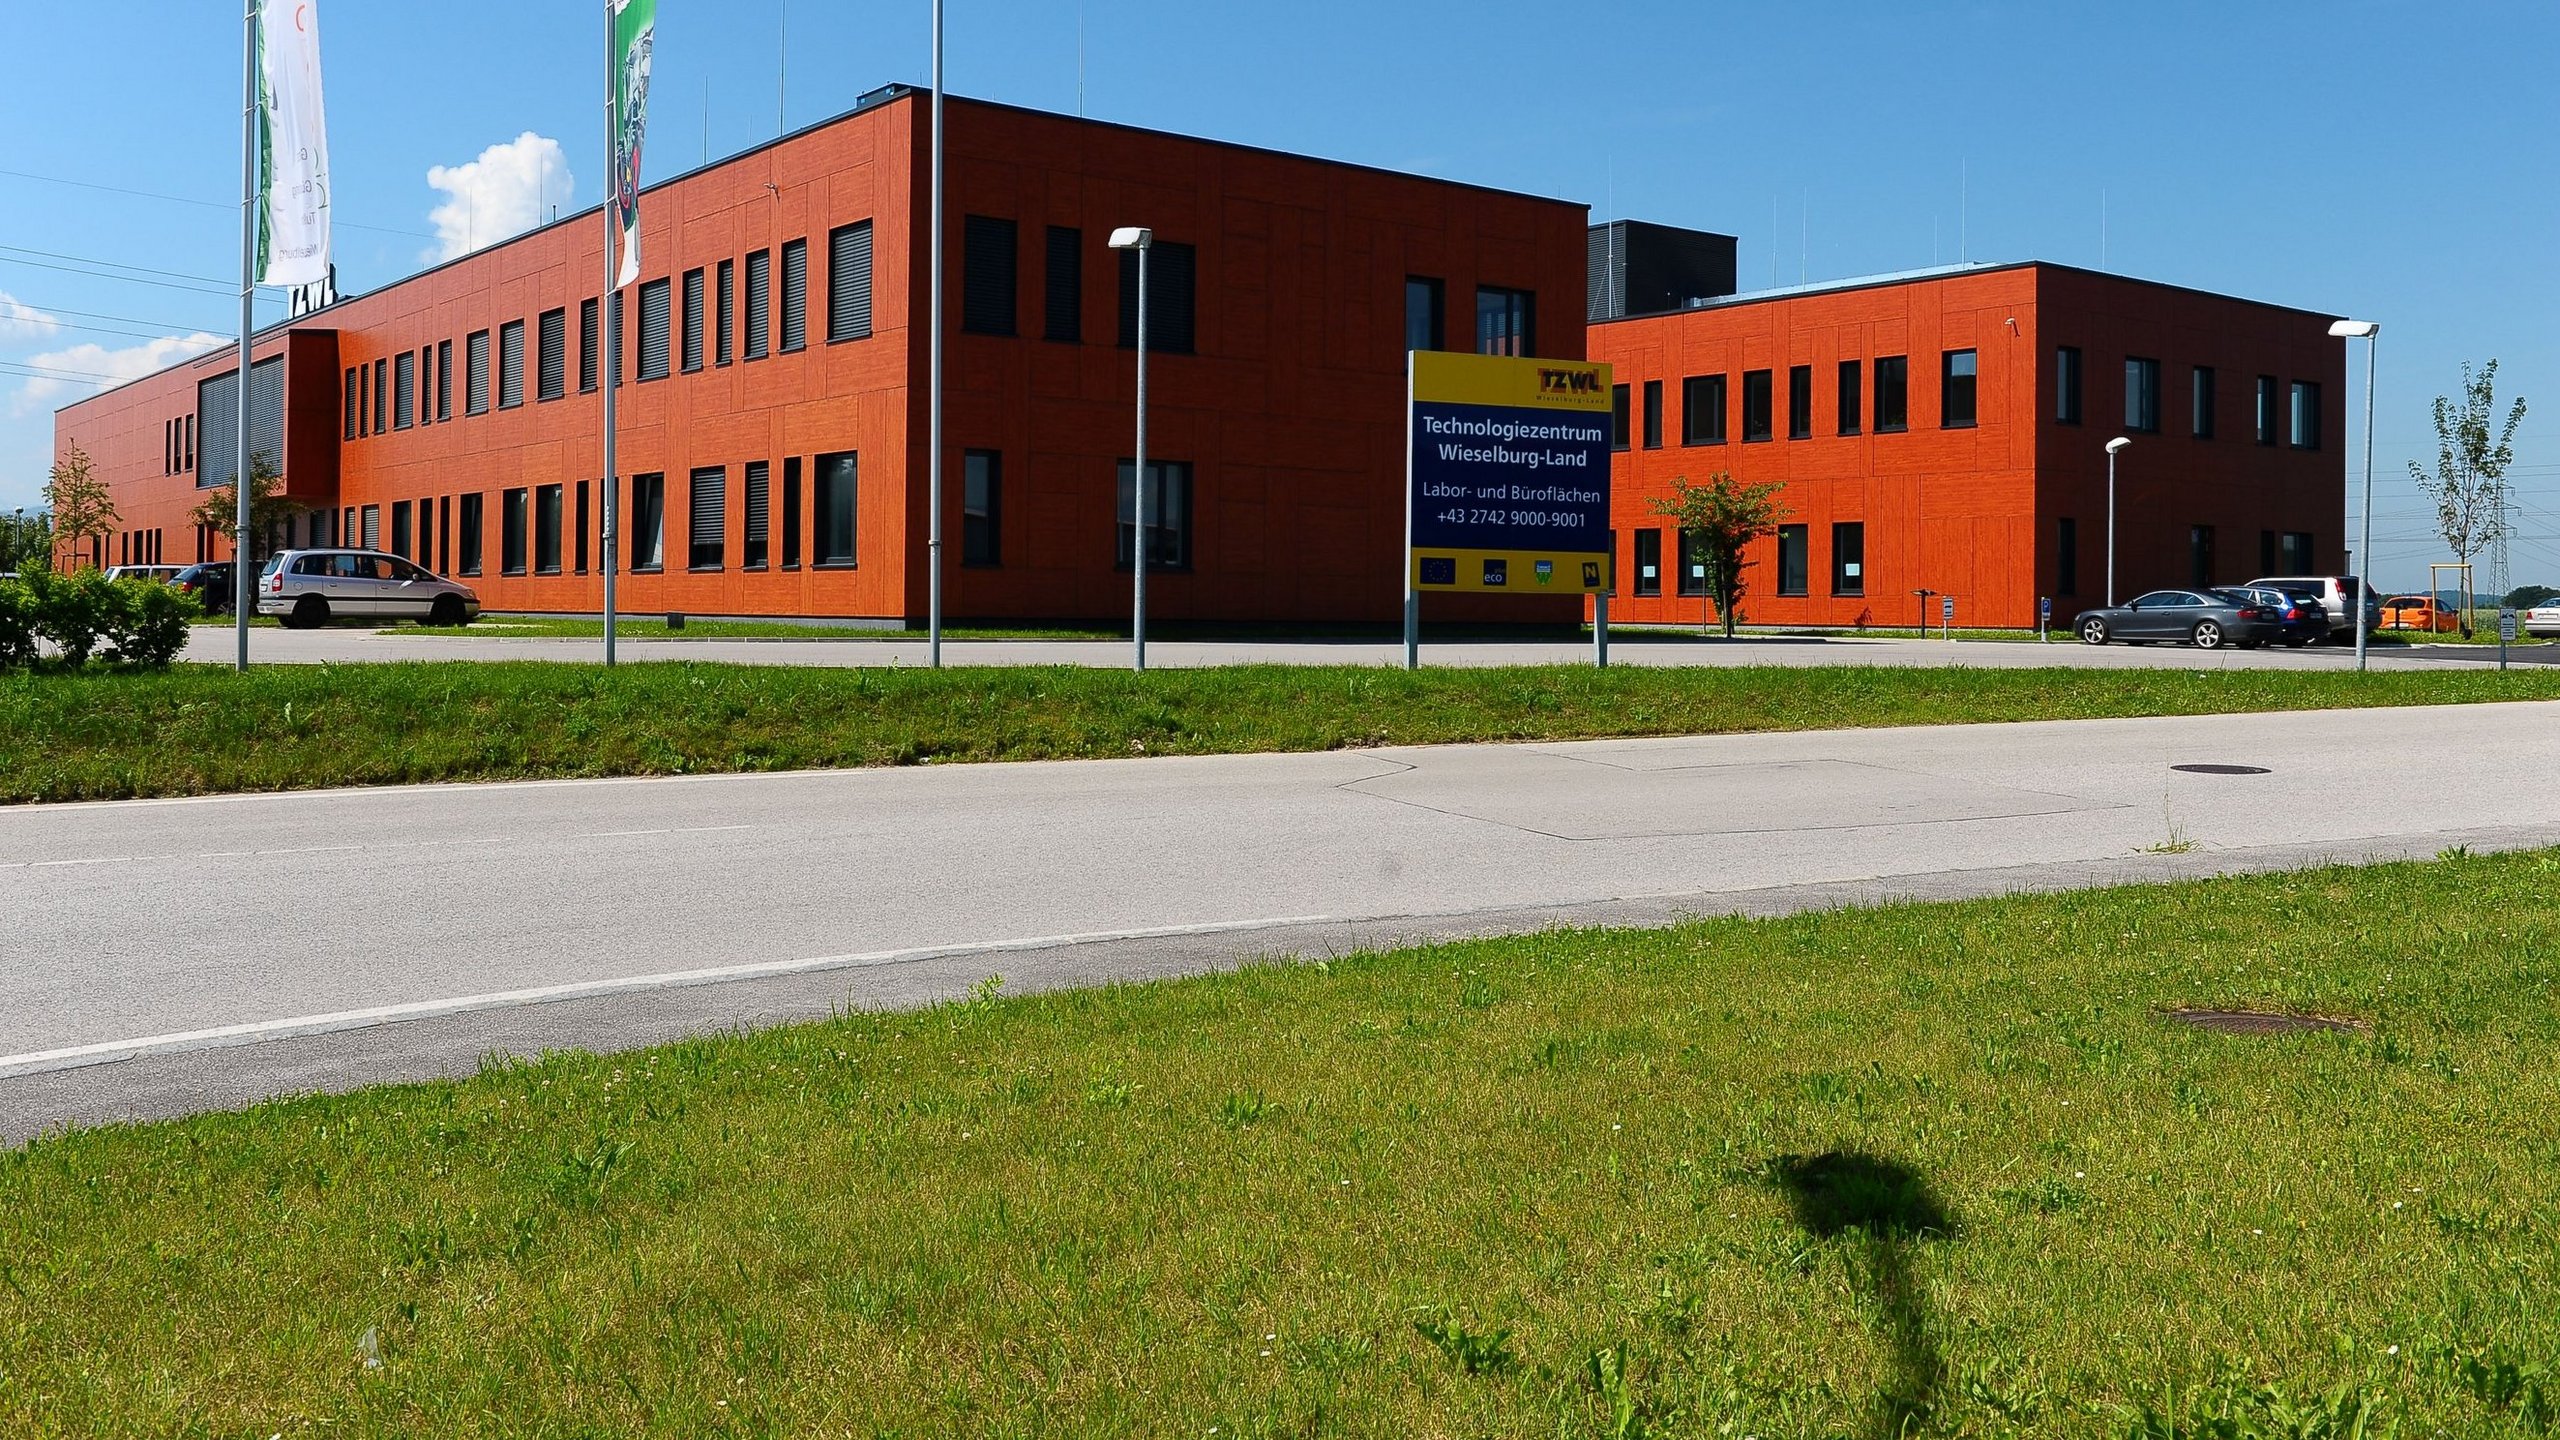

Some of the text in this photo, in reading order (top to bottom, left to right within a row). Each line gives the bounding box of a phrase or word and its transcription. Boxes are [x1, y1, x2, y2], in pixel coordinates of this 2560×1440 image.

[287, 276, 334, 320] TZWL
[1537, 367, 1604, 395] TZWL
[1536, 395, 1605, 404] Wieselburg-Land
[1423, 416, 1602, 442] Technologiezentrum
[1438, 443, 1587, 469] Wieselburg-Land
[1423, 481, 1600, 502] Labor- und Büroflächen
[1437, 508, 1585, 527] +43 2742 9000-9001
[1484, 573, 1503, 583] eco
